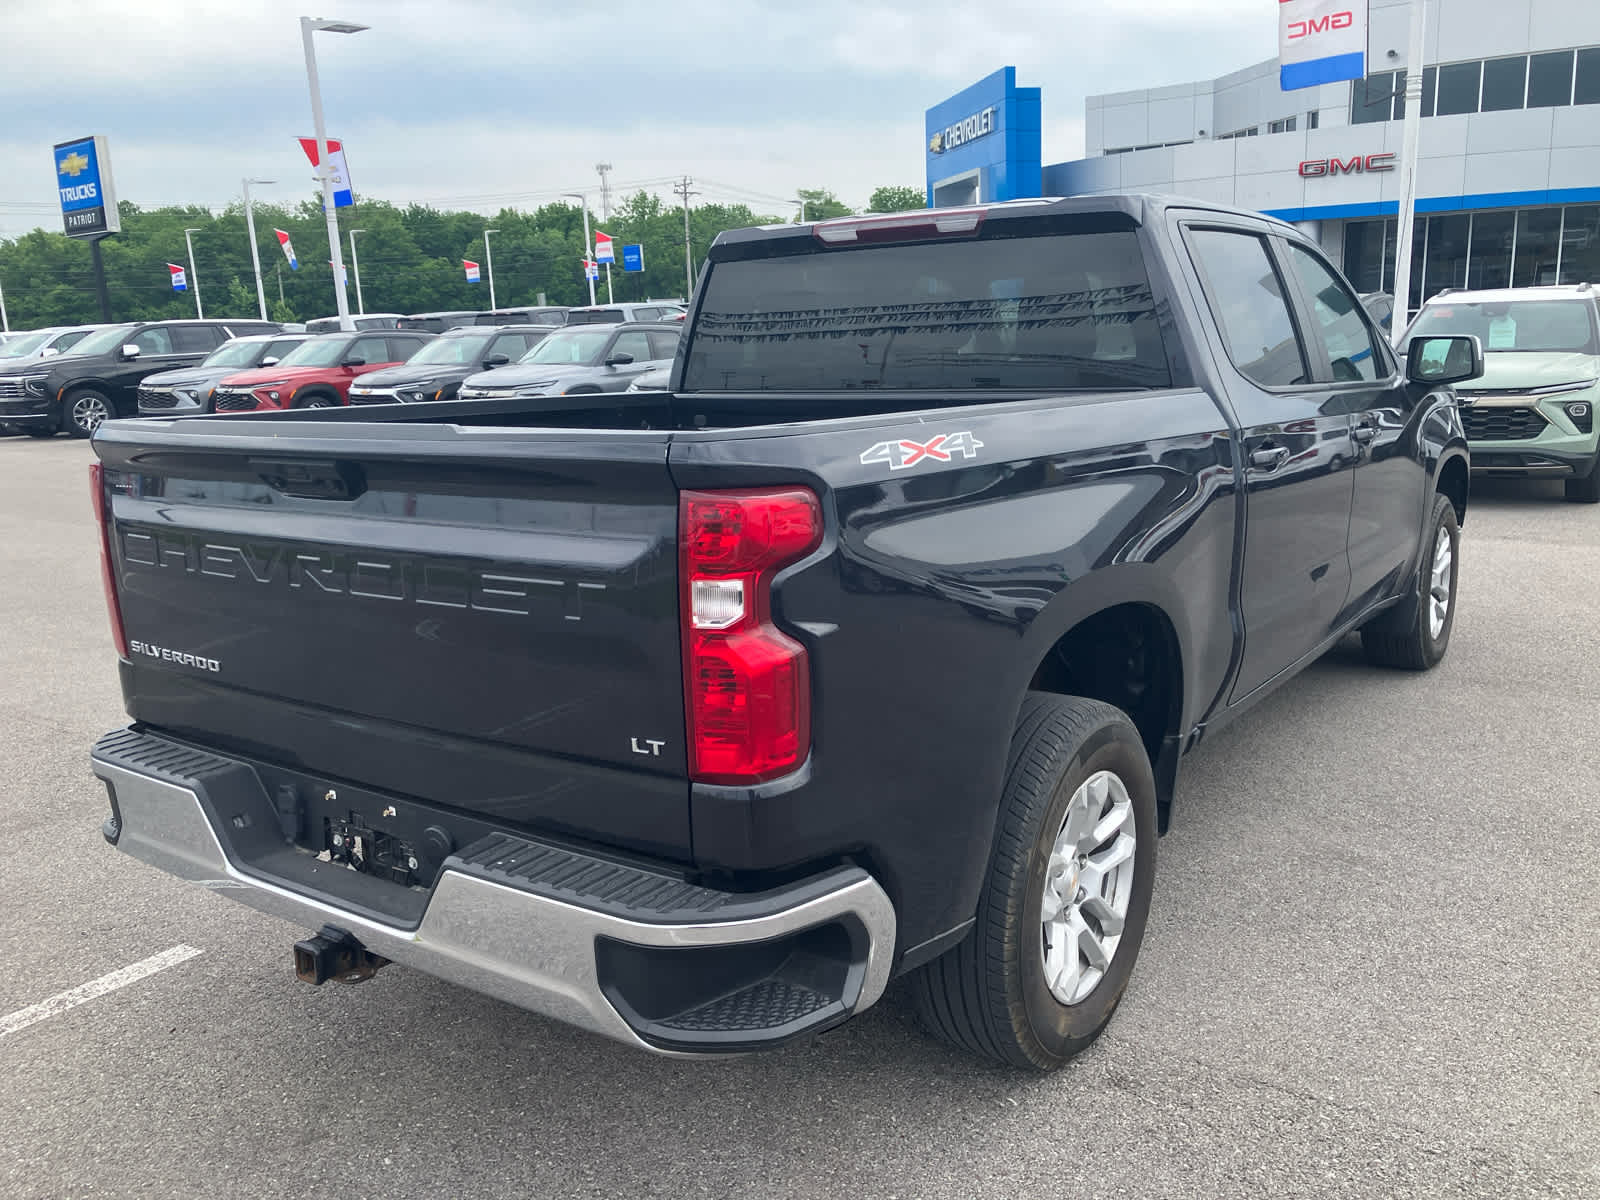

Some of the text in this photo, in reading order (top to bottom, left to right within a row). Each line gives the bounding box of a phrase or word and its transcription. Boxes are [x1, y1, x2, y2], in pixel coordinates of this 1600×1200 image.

[944, 106, 993, 150] CHEVROLET
[1298, 152, 1396, 179] GMC
[60, 182, 97, 202] TRUCKS
[68, 212, 96, 227] PATRIOT
[122, 532, 607, 621] CHEVROLET
[131, 640, 221, 673] SILVERADO
[630, 737, 666, 756] LT
